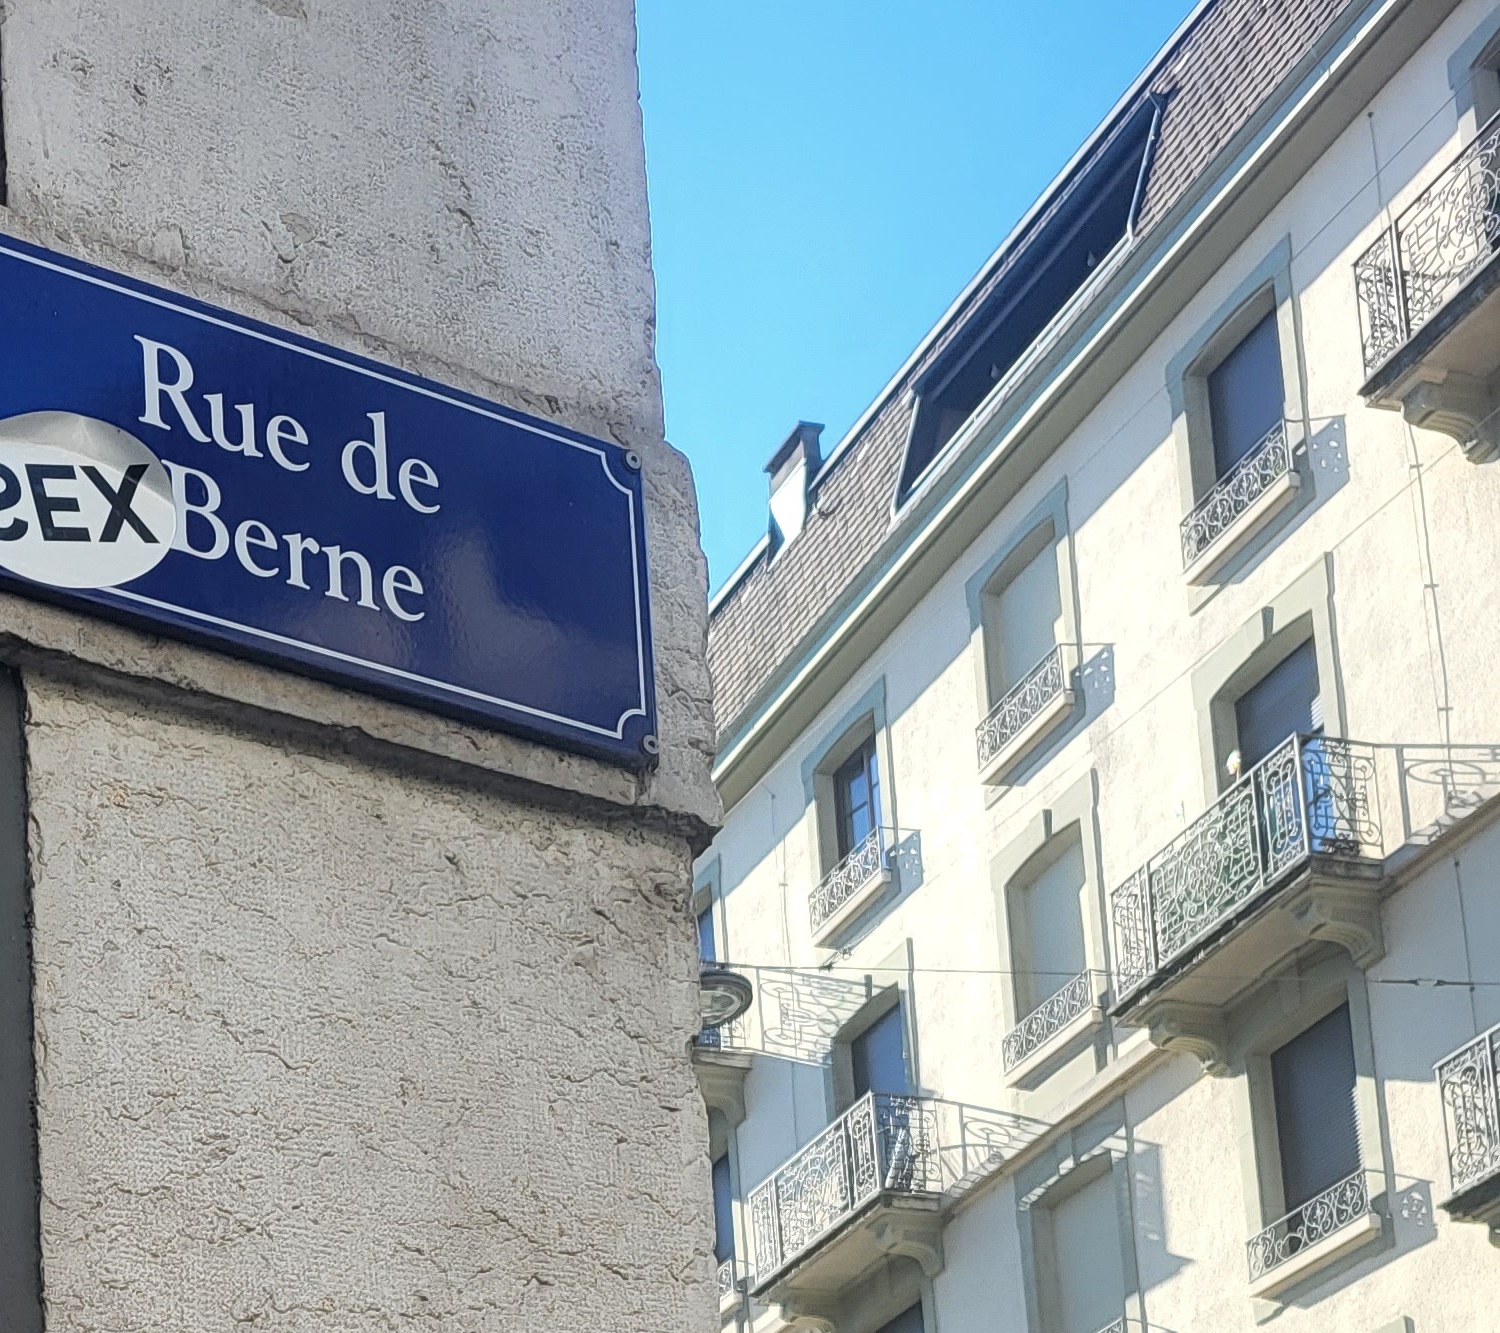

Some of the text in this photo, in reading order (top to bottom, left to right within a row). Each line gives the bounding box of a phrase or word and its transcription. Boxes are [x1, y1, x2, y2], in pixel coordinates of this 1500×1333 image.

[133, 333, 441, 516] Rue de
[161, 457, 427, 622] Berne
